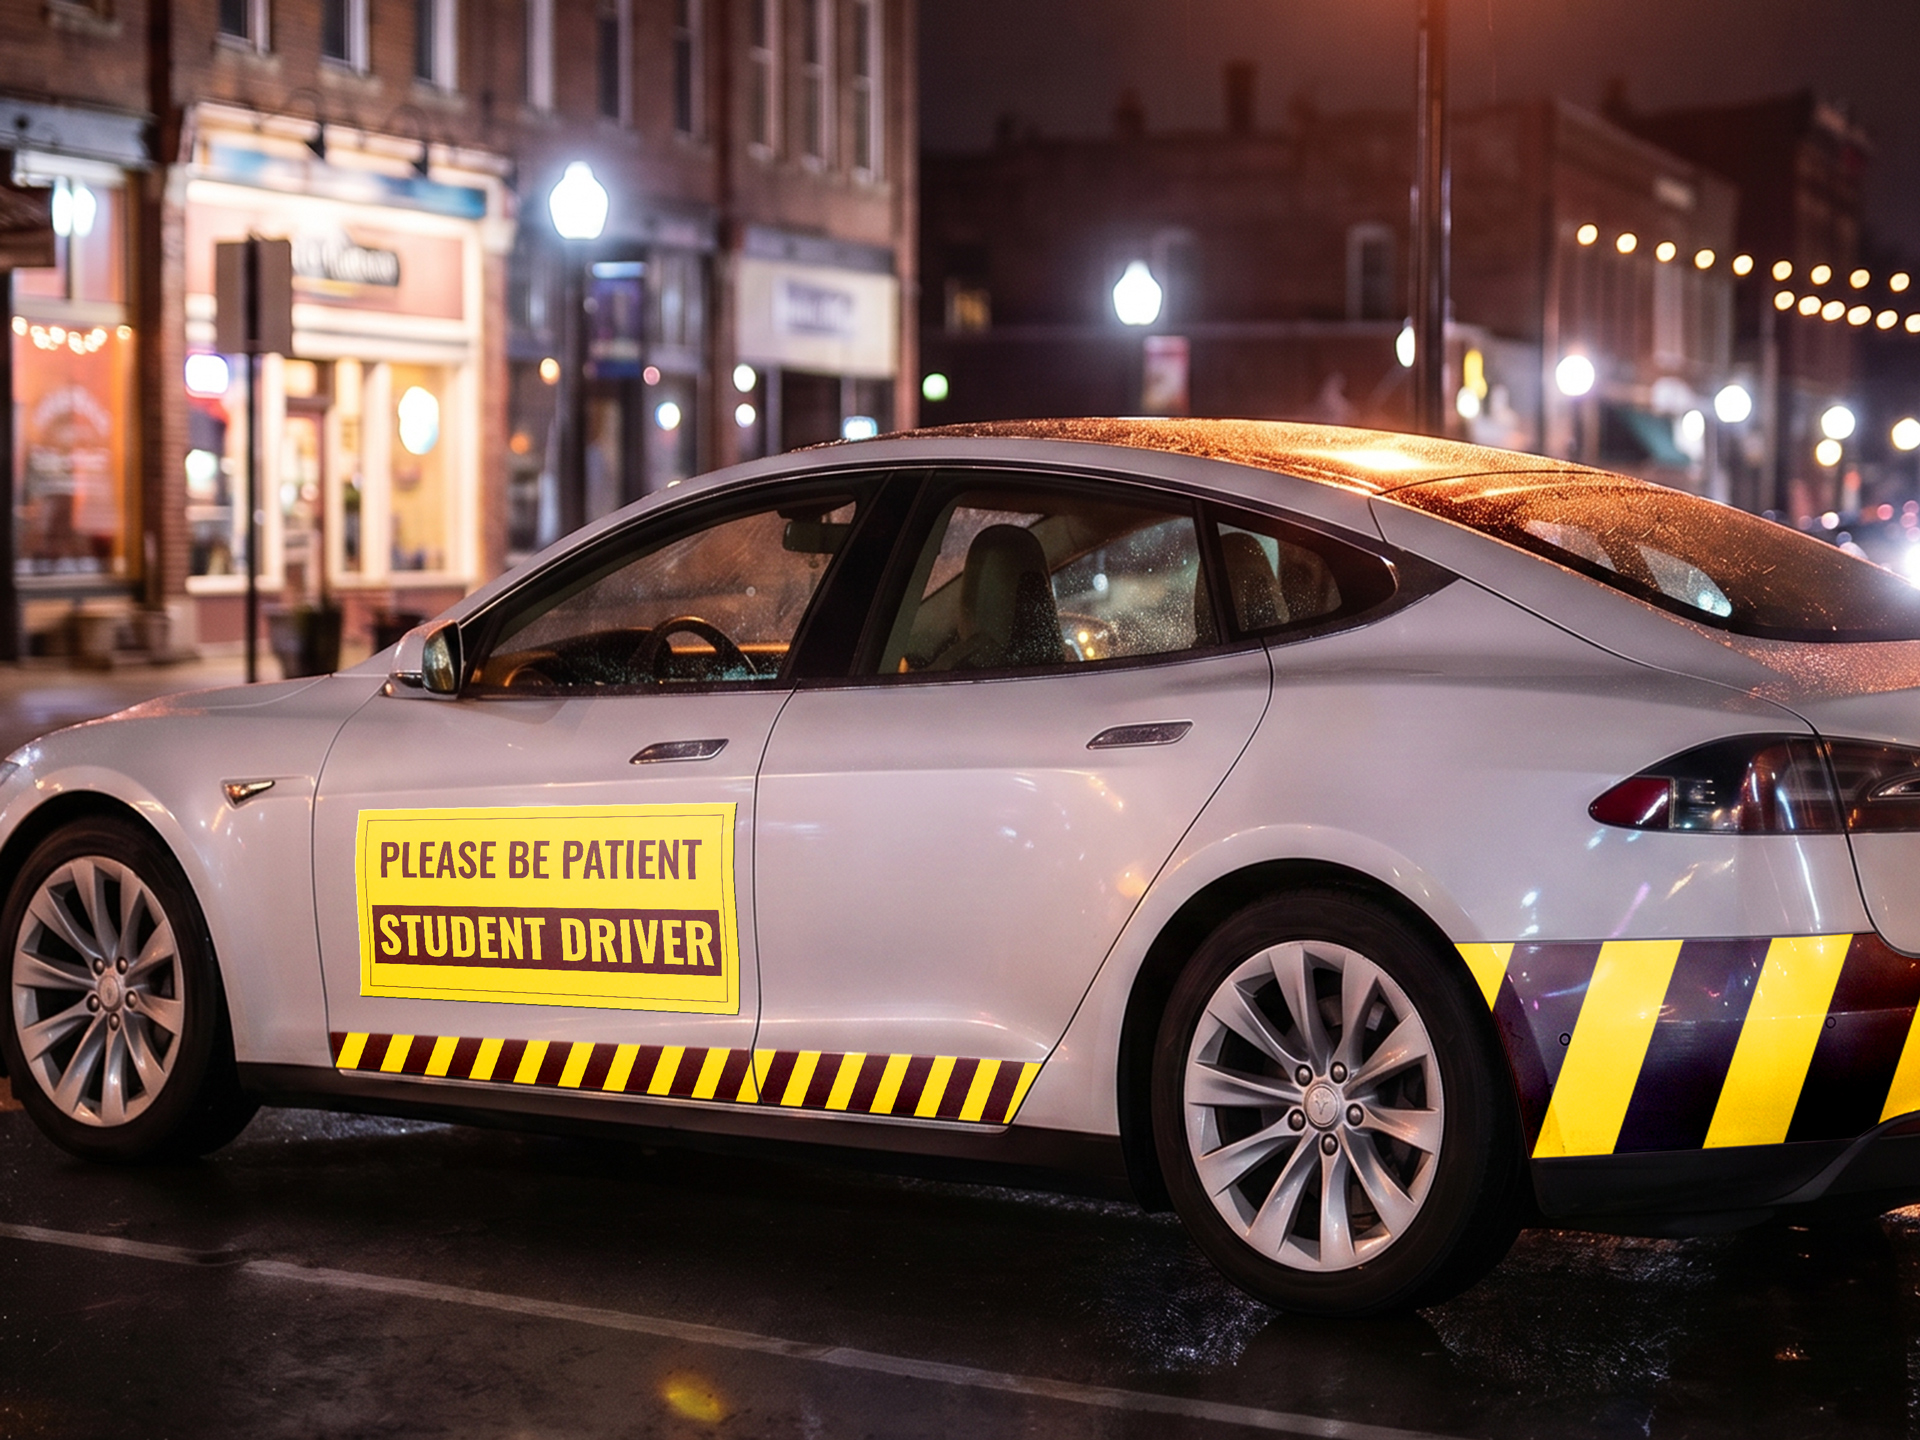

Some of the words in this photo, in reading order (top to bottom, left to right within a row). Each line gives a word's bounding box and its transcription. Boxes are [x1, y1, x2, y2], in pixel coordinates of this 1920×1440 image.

[380, 841, 497, 879] PLEASE
[508, 840, 550, 879] BE
[562, 839, 702, 879] PATIENT
[379, 914, 546, 960] STUDENT
[560, 917, 715, 967] DRIVER
